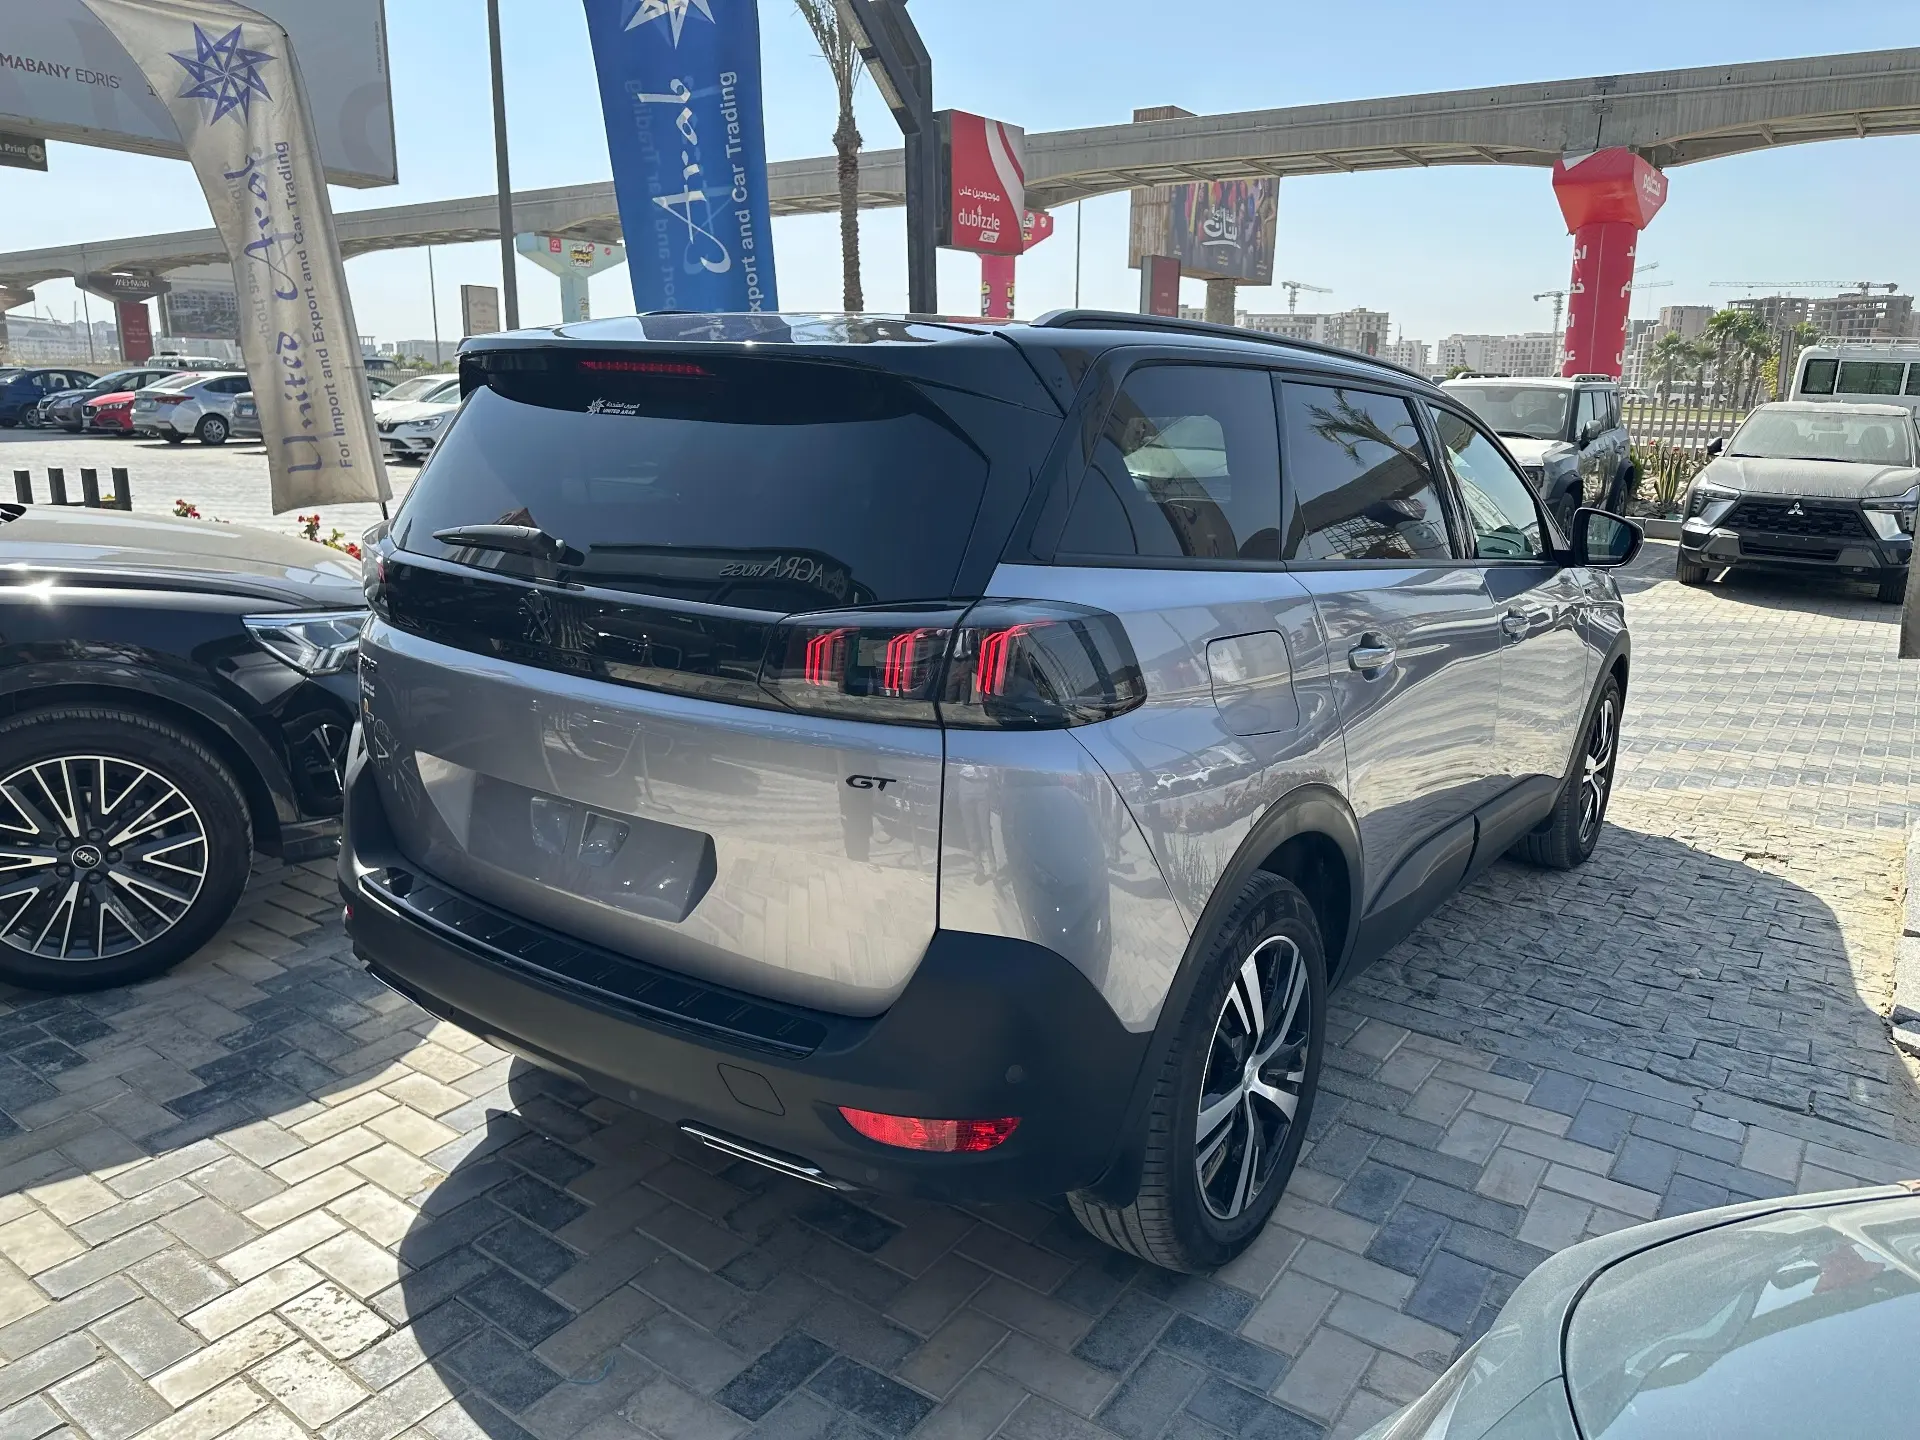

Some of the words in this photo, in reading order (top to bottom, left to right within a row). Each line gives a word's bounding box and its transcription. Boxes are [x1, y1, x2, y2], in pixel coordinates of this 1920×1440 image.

[0, 53, 70, 79] MABANY
[75, 68, 120, 89] EDRIS
[720, 71, 742, 158] Trading
[274, 141, 299, 210] Trading
[637, 78, 731, 273] Arab
[731, 163, 748, 203] Car
[958, 185, 972, 196] على
[972, 187, 1000, 203] موجودين
[223, 154, 298, 301] Arab
[292, 214, 304, 244] Car
[734, 209, 754, 250] and
[958, 204, 1000, 231] dubizzle
[982, 232, 996, 242] Cars
[297, 250, 312, 282] and
[741, 256, 764, 313] xport
[304, 286, 324, 343] Export
[316, 348, 333, 379] and
[276, 331, 322, 474] United
[324, 382, 346, 437] Import
[338, 441, 353, 468] For
[845, 775, 897, 791] GT
